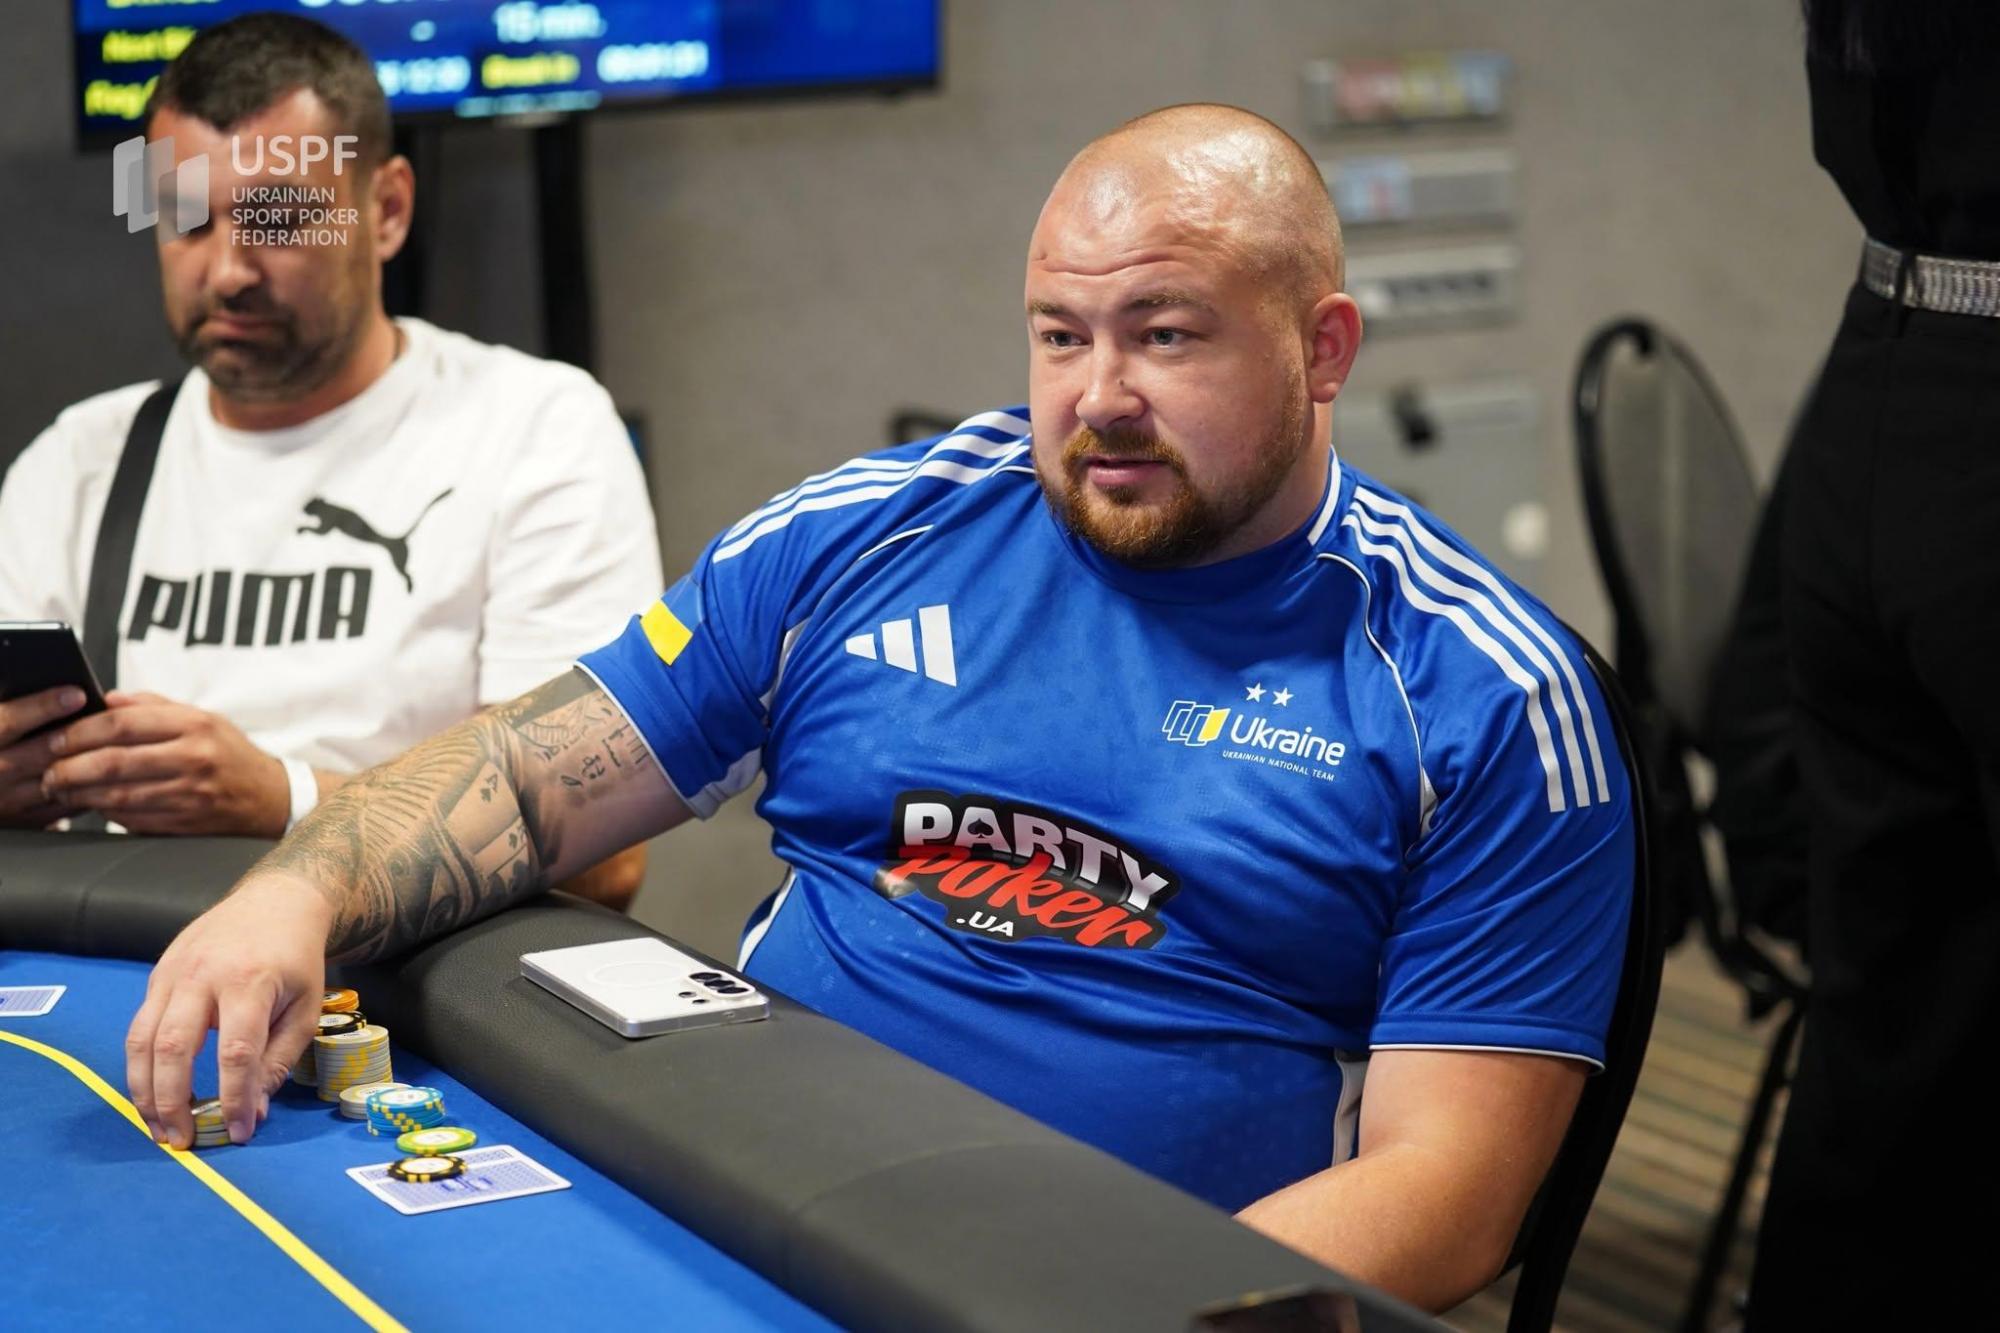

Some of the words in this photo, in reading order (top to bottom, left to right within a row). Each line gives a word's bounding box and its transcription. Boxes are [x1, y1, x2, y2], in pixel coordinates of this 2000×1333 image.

[127, 567, 373, 647] PUMA
[1222, 750, 1265, 764] UKRAINIAN
[1267, 759, 1308, 776] NATIONAL
[1312, 769, 1335, 782] TEAM
[1230, 714, 1346, 766] Ukraine
[903, 803, 1169, 911] PARTY
[956, 911, 1014, 937] .UA
